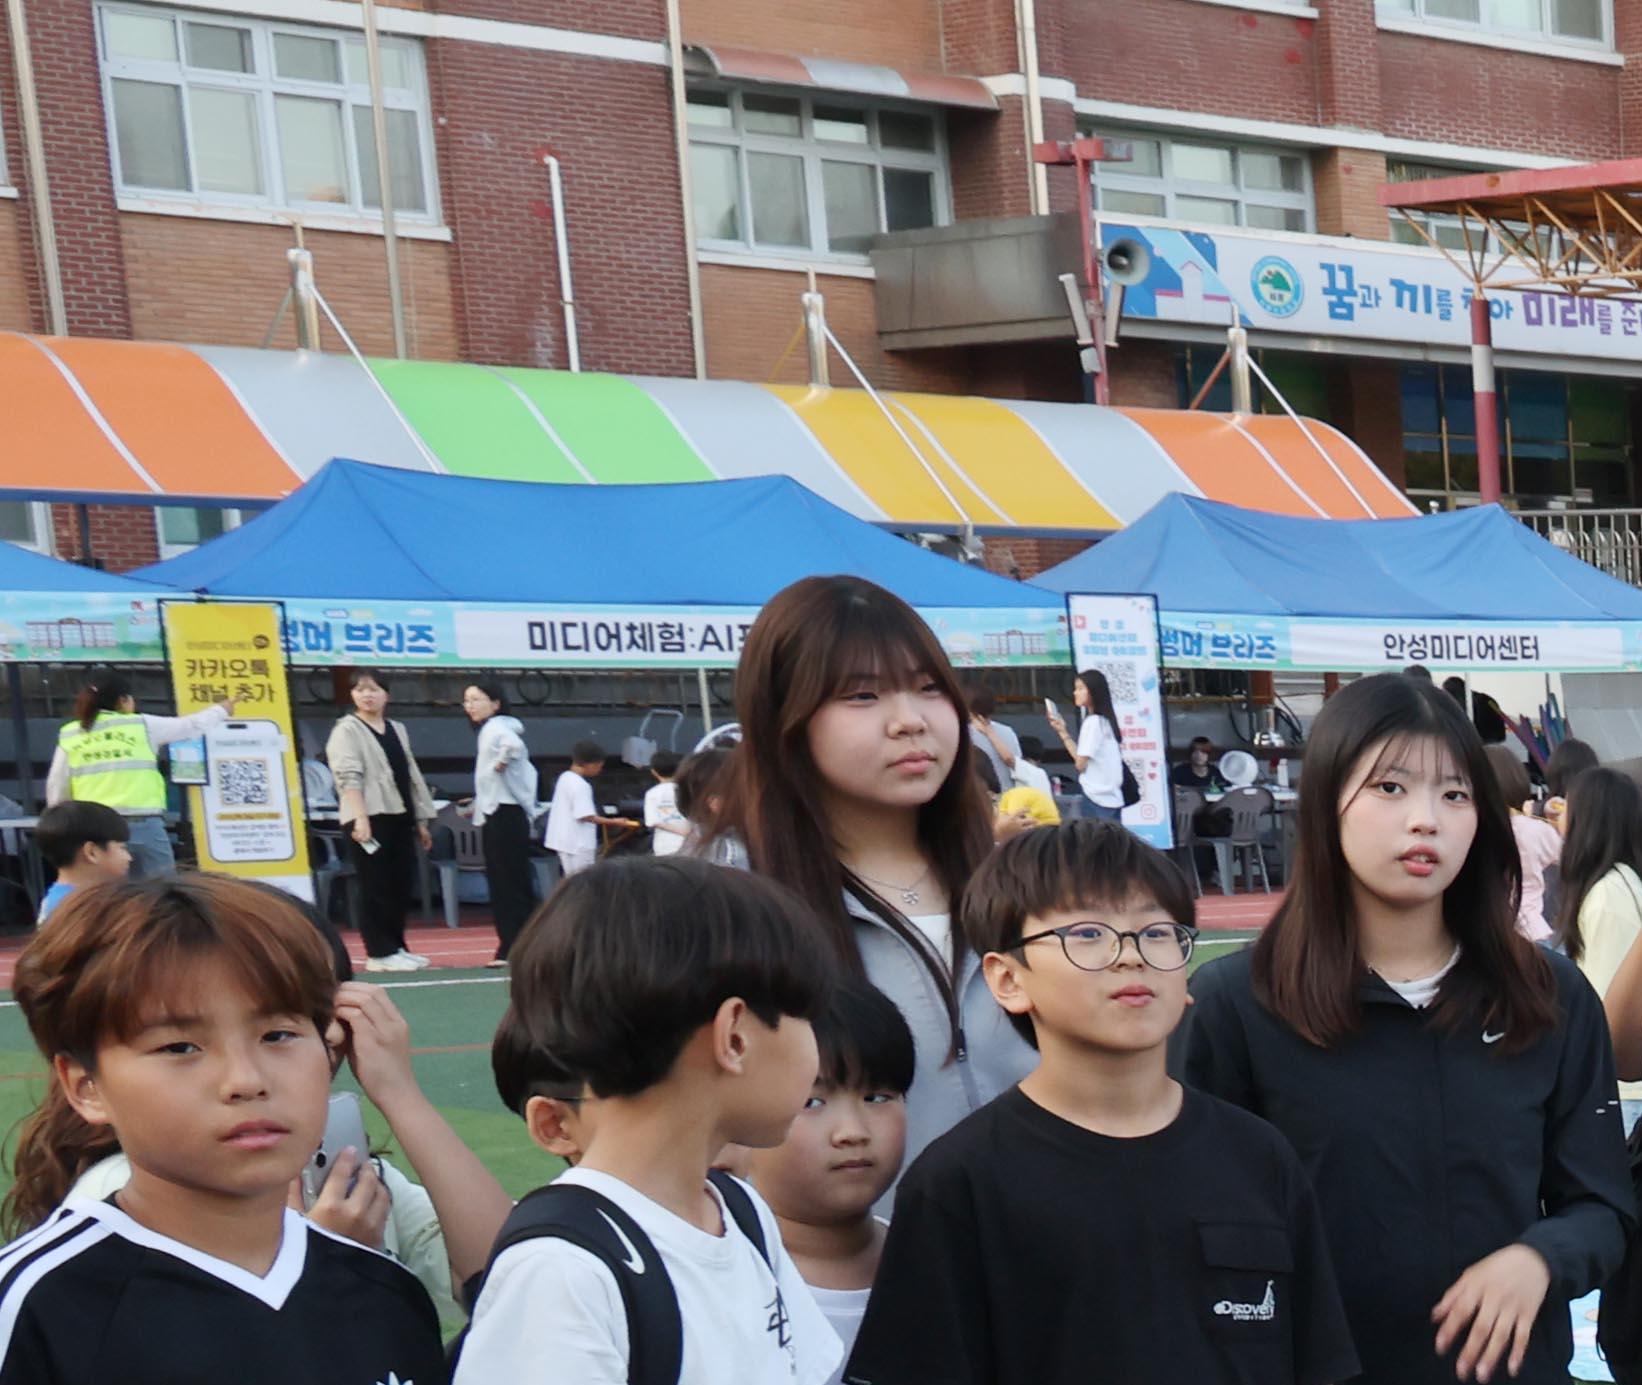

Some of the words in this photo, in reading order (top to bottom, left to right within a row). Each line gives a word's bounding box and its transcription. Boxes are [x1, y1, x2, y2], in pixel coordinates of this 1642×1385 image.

[1319, 262, 1382, 322] 꿈과
[1389, 278, 1453, 322] 끼를
[1521, 291, 1613, 336] 미래를
[344, 622, 436, 654] 브리즈
[1211, 632, 1277, 661] 브리즈
[1383, 633, 1540, 662] 안성미디어센터
[185, 658, 271, 679] 카카오톡
[189, 683, 230, 704] 채널
[236, 683, 277, 704] 추가
